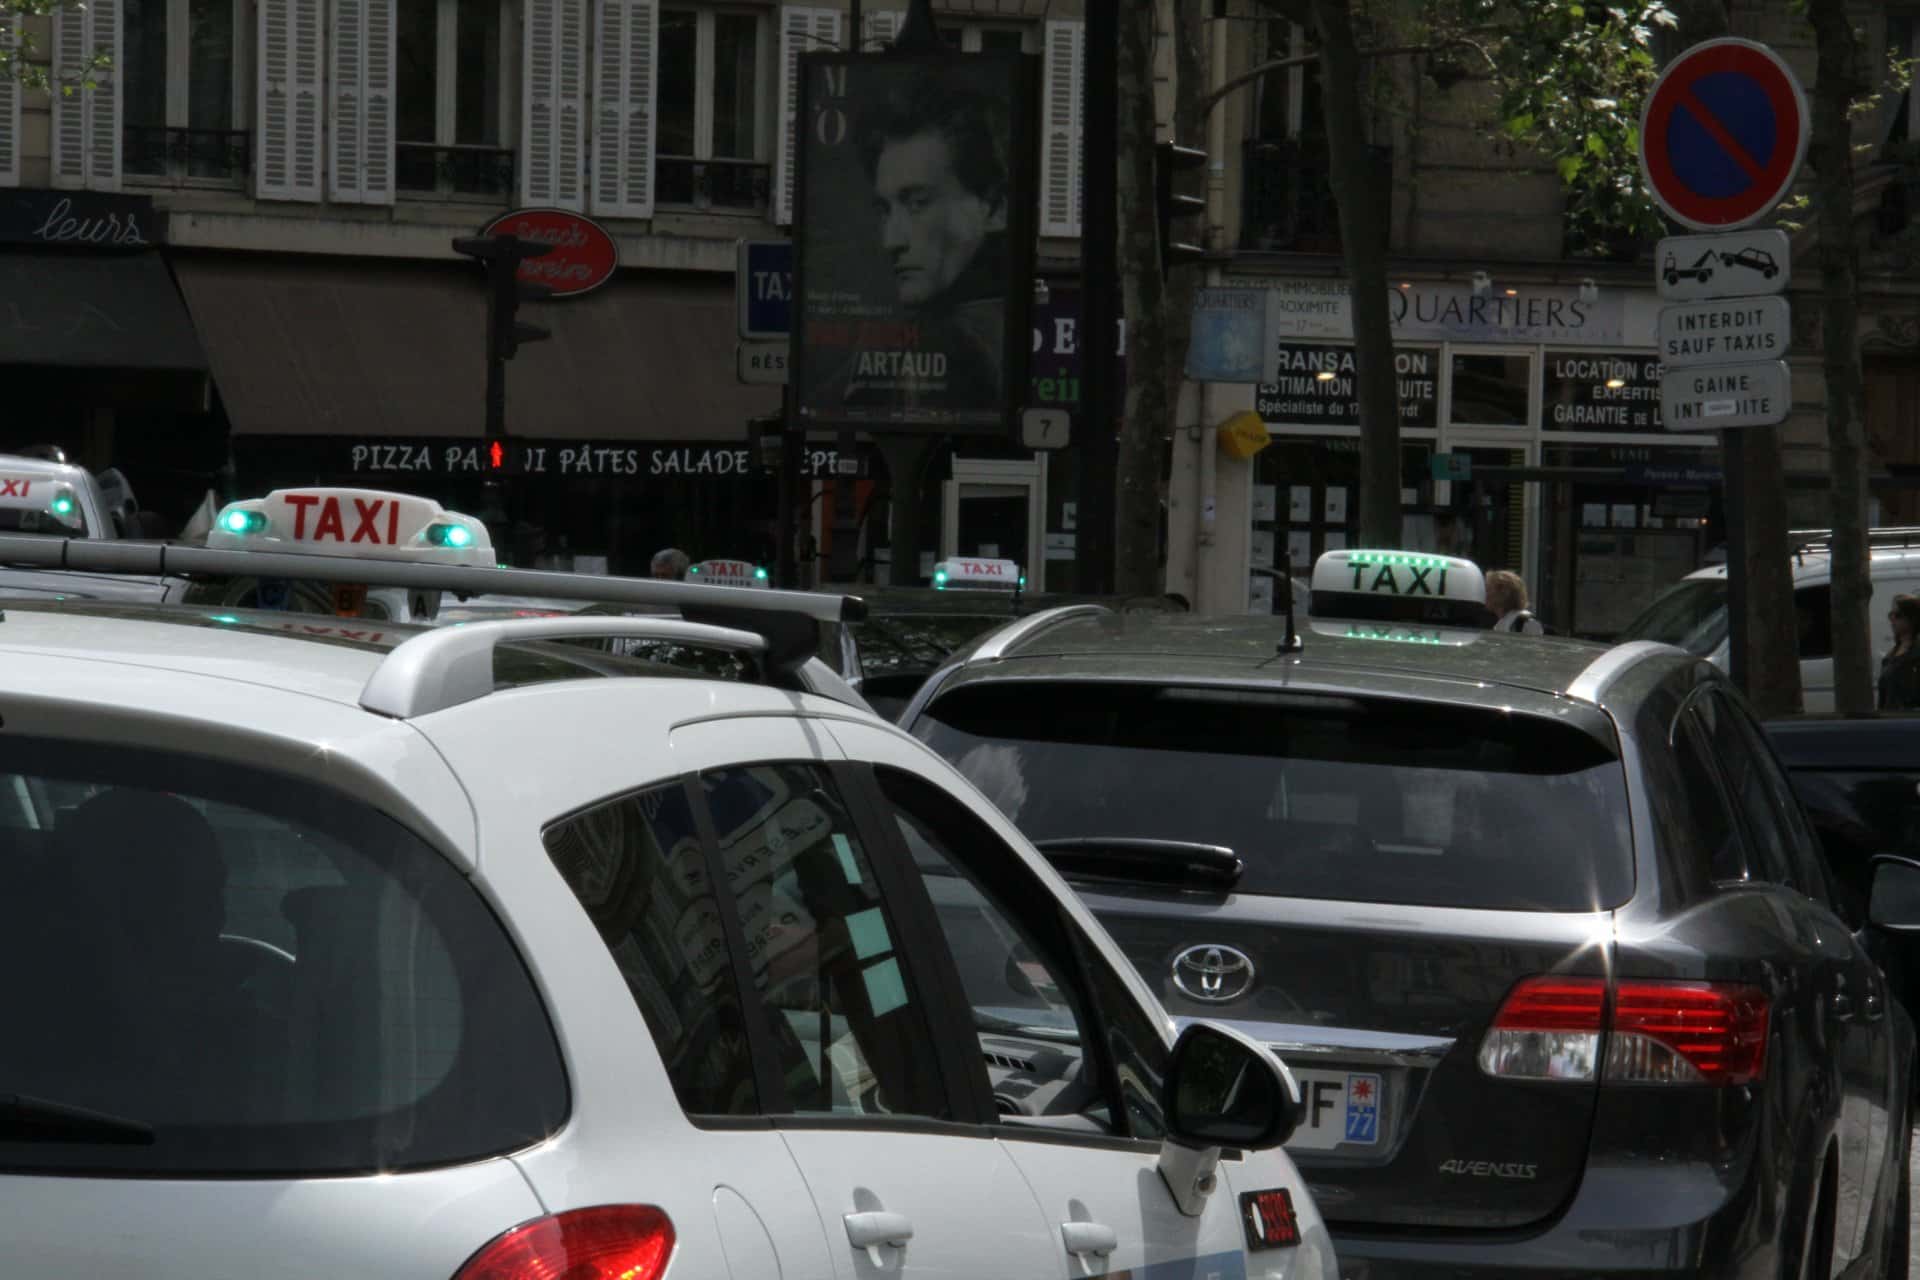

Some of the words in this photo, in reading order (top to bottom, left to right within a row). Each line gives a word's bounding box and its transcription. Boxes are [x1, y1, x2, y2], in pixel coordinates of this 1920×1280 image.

[32, 198, 149, 244] leurs
[1391, 287, 1586, 330] QUARTIERS
[1677, 309, 1764, 331] INTERDIT
[1668, 337, 1715, 356] SAUF
[1723, 332, 1776, 352] TAXIS
[857, 351, 949, 378] ARTAUD
[1556, 359, 1638, 381] LOCATION
[1693, 375, 1750, 394] GAINE
[1328, 402, 1345, 416] du
[1553, 403, 1629, 424] GARANTIE
[1674, 398, 1770, 420] INTITE
[1039, 419, 1053, 440] 7
[351, 444, 432, 473] PIZZA
[559, 443, 639, 475] PÂTES
[650, 448, 749, 477] SALADE
[284, 494, 400, 545] TAXI
[709, 561, 744, 577] TAXI
[960, 562, 1003, 575] TAXI
[1348, 562, 1448, 596] TAXI
[1349, 1111, 1374, 1136] 77
[1439, 1159, 1537, 1180] AVENSIS
